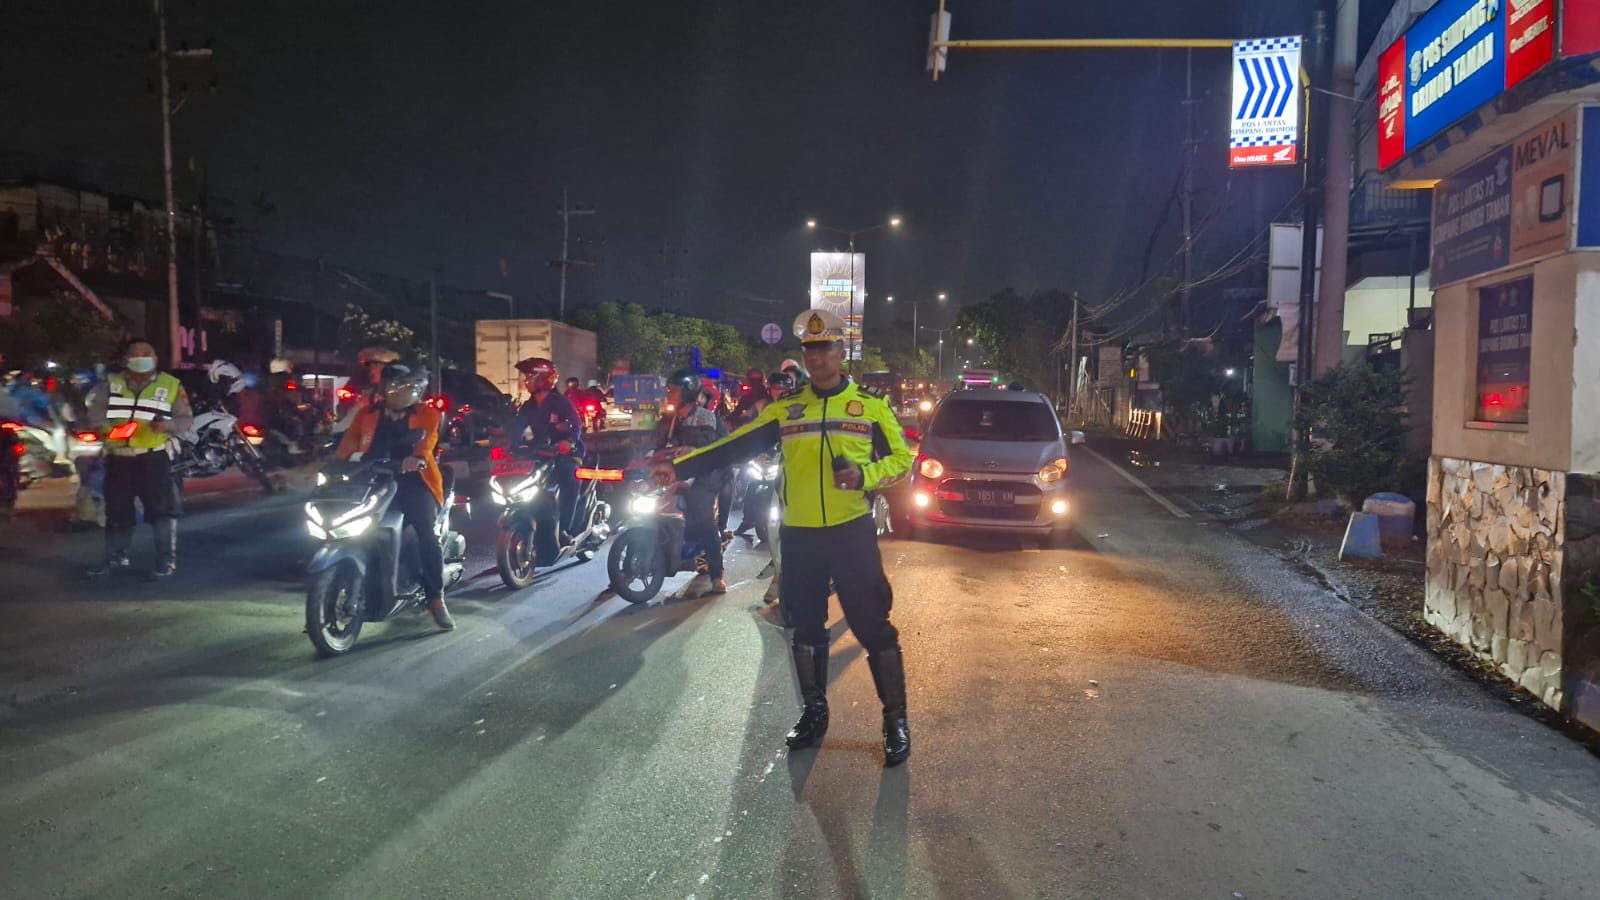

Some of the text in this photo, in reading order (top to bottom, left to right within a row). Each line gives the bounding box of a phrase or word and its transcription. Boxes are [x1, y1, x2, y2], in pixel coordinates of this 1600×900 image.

[1422, 0, 1487, 72] POS SIMPANG
[1412, 32, 1494, 117] BRIMOB TAMAN
[1241, 119, 1287, 128] POS LANTAS
[1514, 122, 1569, 173] MEVAL
[1460, 180, 1485, 209] LANTAS
[1485, 193, 1511, 223] TAMAN
[841, 422, 868, 432] POLISI
